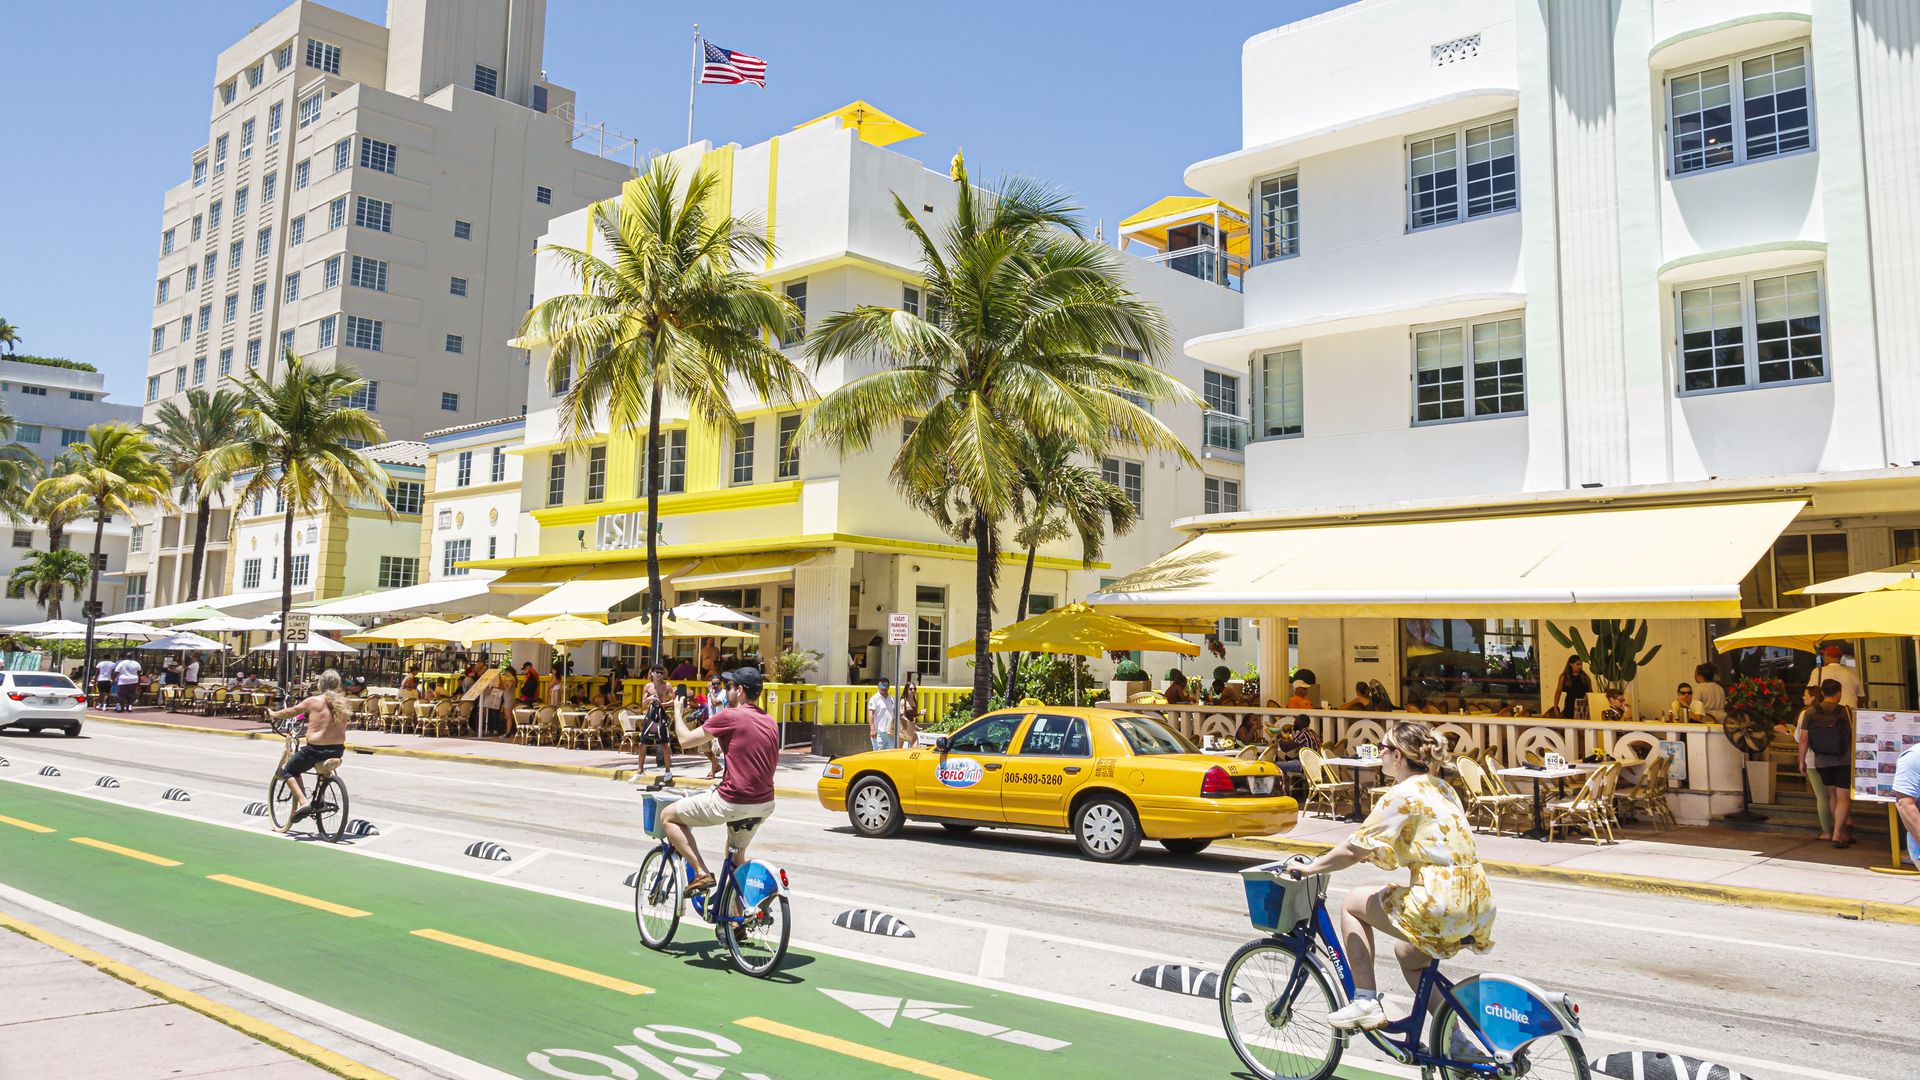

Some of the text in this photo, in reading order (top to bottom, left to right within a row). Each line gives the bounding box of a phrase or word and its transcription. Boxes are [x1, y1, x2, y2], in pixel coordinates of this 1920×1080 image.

[287, 629, 306, 640] 25
[939, 770, 964, 781] SOFLO
[1004, 772, 1063, 786] 305-893-5260
[1328, 945, 1345, 979] citi bike
[1485, 1002, 1529, 1024] citi bike
